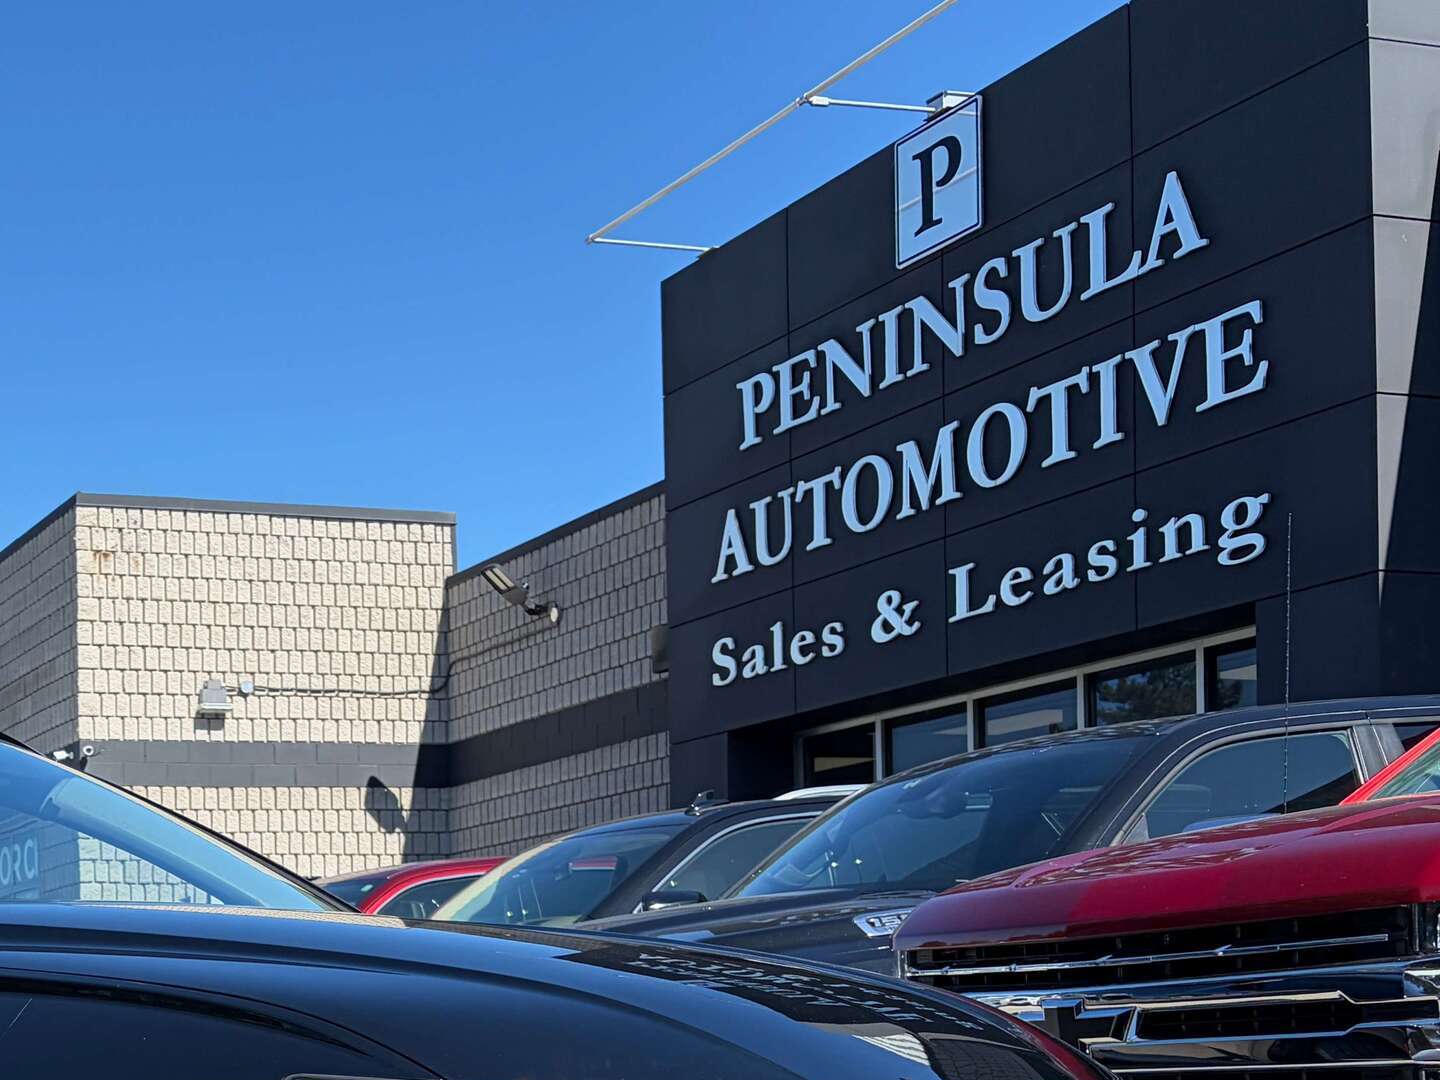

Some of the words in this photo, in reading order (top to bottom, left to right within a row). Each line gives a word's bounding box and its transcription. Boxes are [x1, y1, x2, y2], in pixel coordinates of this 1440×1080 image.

[911, 134, 963, 237] P
[735, 170, 1210, 451] PENINSULA
[711, 299, 1269, 584] AUTOMOTIVE
[711, 619, 846, 687] Sales
[869, 588, 922, 644] &
[947, 492, 1272, 624] Leasing
